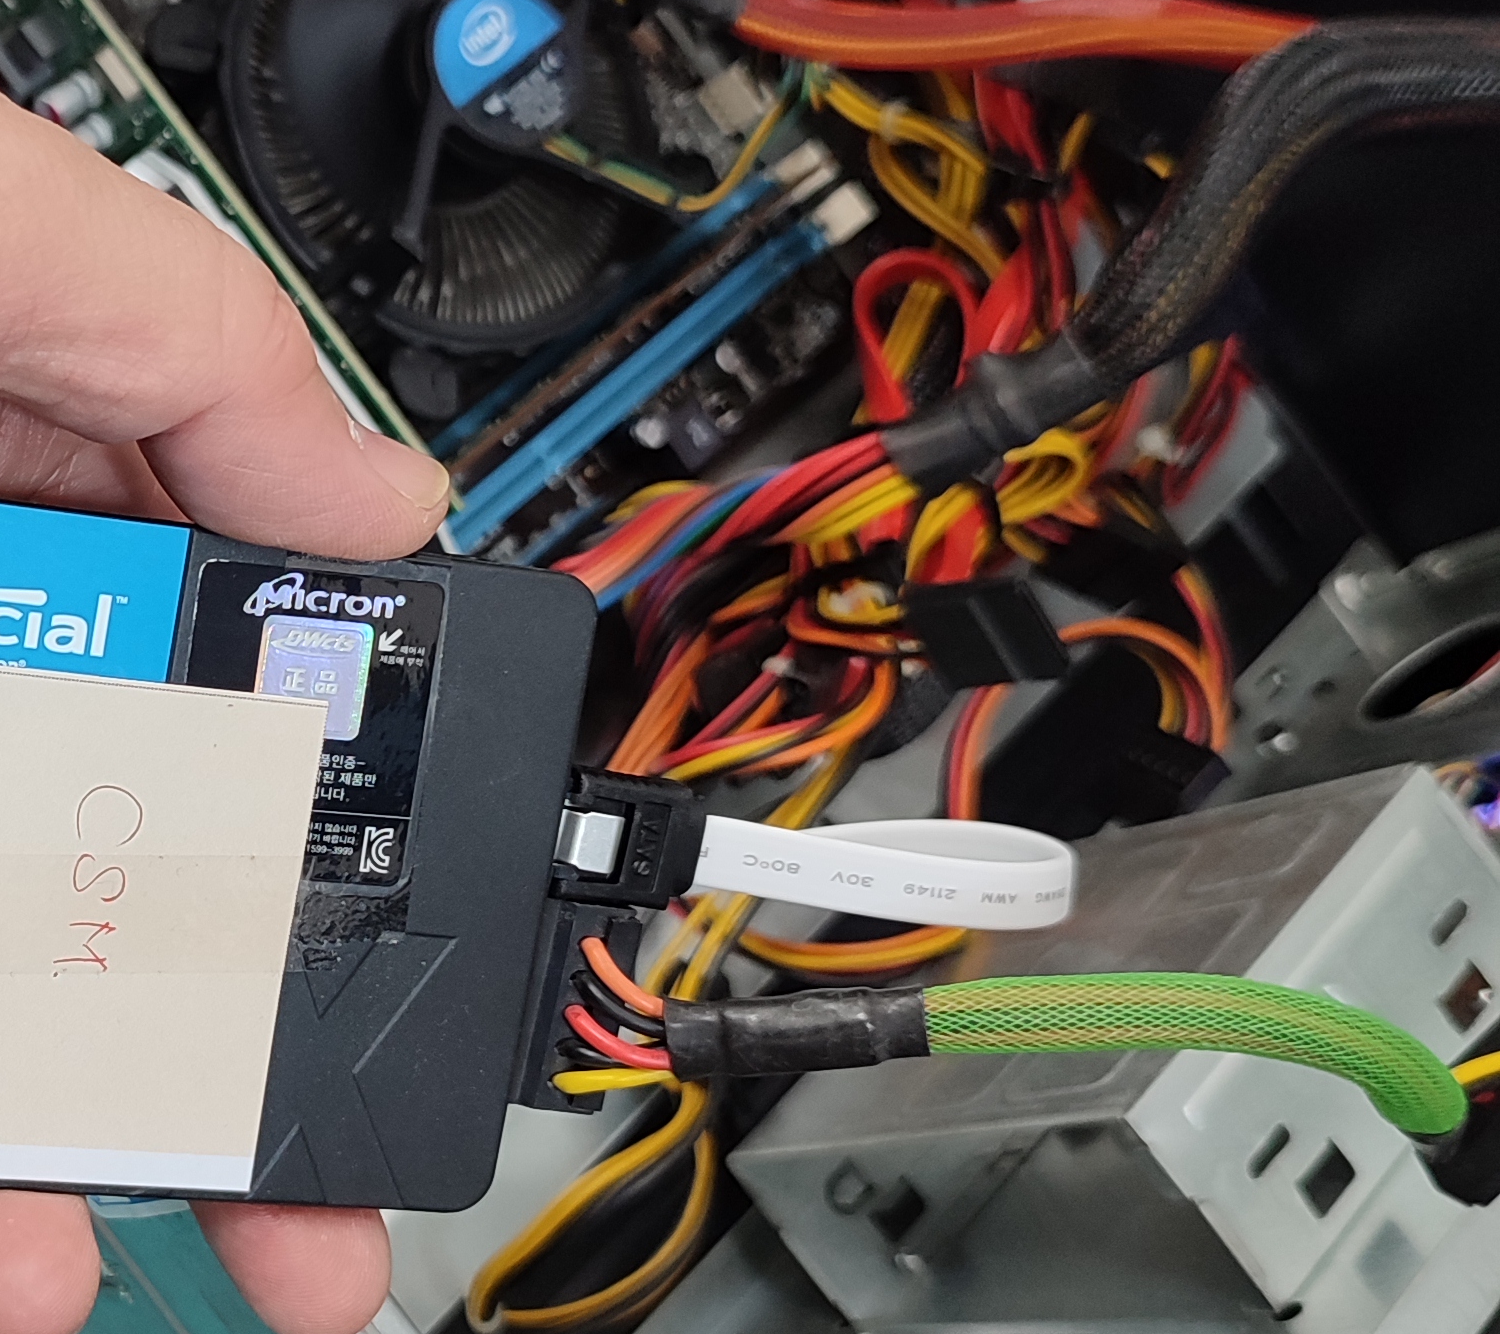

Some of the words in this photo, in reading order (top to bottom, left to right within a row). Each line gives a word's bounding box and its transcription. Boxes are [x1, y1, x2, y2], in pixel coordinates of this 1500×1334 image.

[243, 572, 396, 619] Micron
[283, 666, 340, 696] 正品
[338, 771, 377, 788] 제품만
[742, 853, 801, 875] 80°C
[830, 869, 875, 889] 30V
[902, 882, 958, 901] 21149
[980, 890, 1018, 905] AWM
